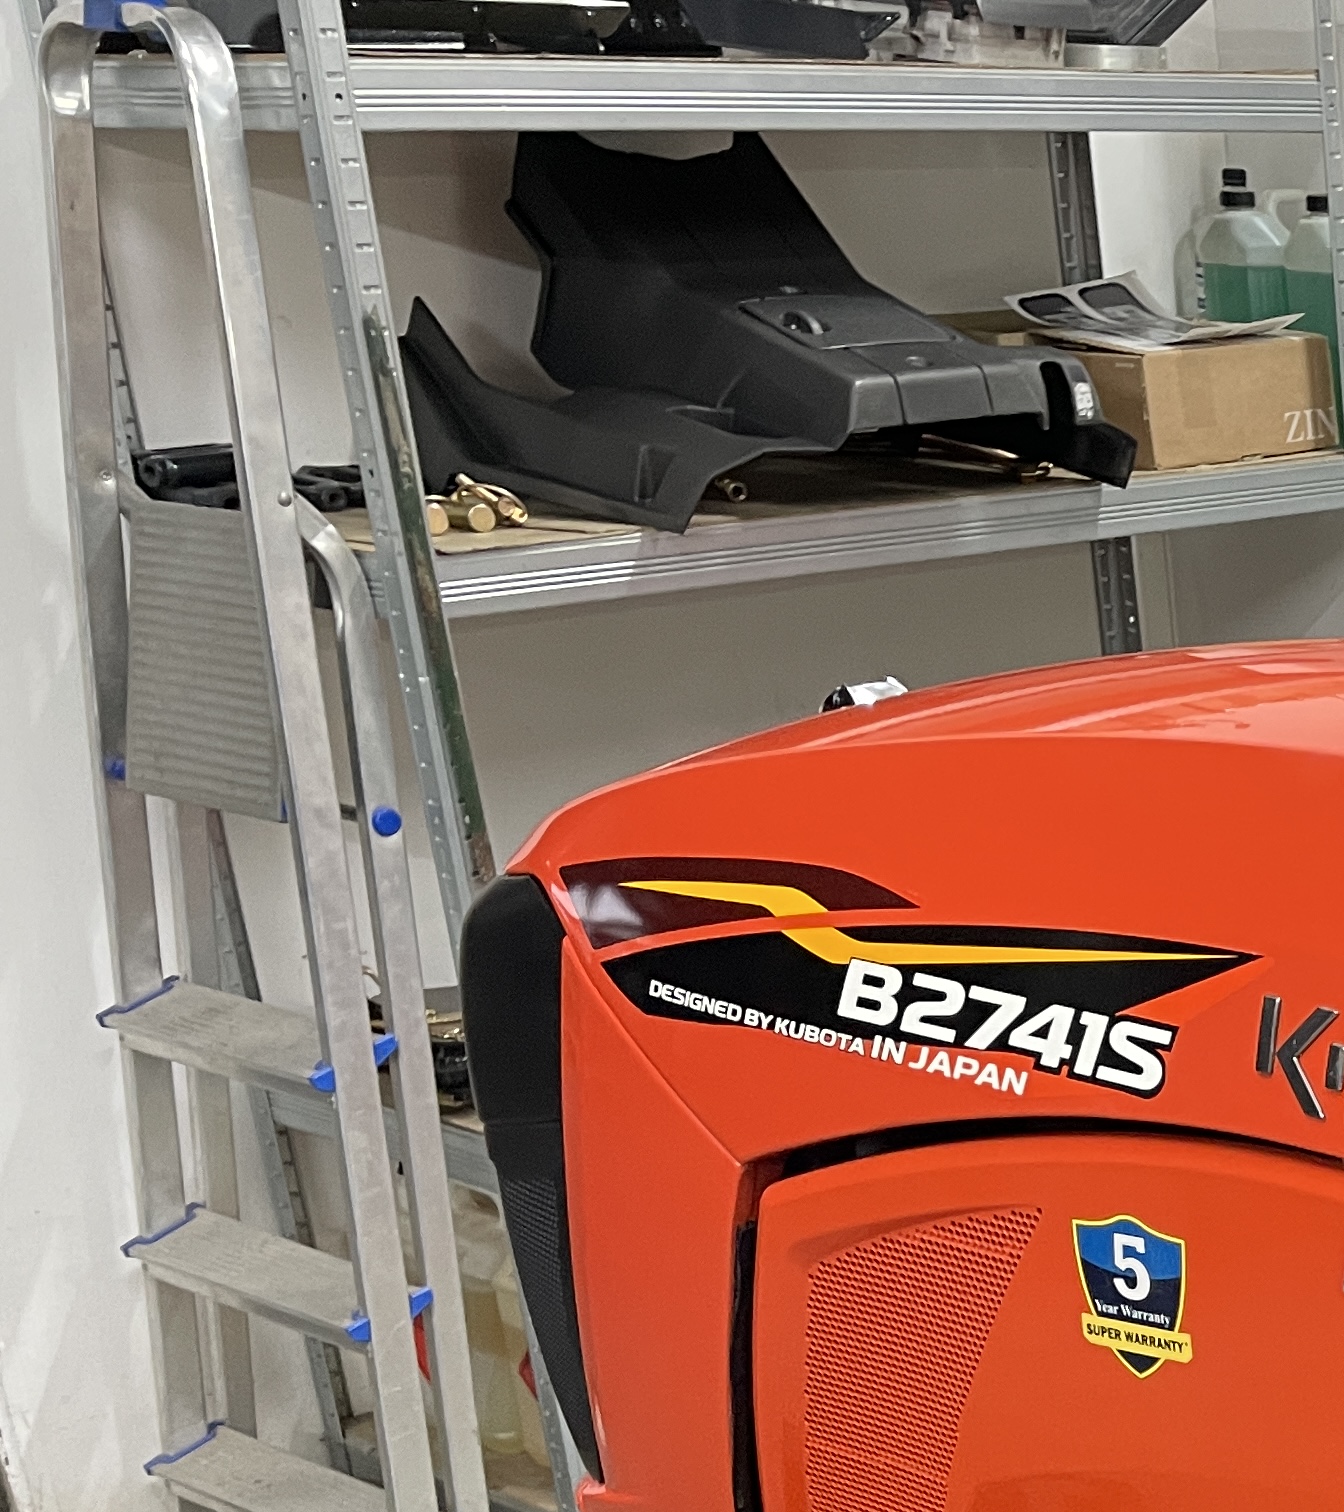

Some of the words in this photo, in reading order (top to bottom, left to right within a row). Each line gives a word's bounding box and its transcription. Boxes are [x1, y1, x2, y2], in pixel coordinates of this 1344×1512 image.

[647, 978, 743, 1024] DESIGNED
[742, 1007, 775, 1030] BY
[772, 1018, 867, 1057] KUBOTA
[869, 1034, 910, 1066] IN
[907, 1045, 1030, 1098] JAPAN
[836, 956, 1176, 1095] B2741S
[1112, 1232, 1151, 1302] 5
[1086, 1322, 1122, 1342] SUPER
[1094, 1298, 1119, 1314] Year
[1120, 1303, 1171, 1329] Warranty
